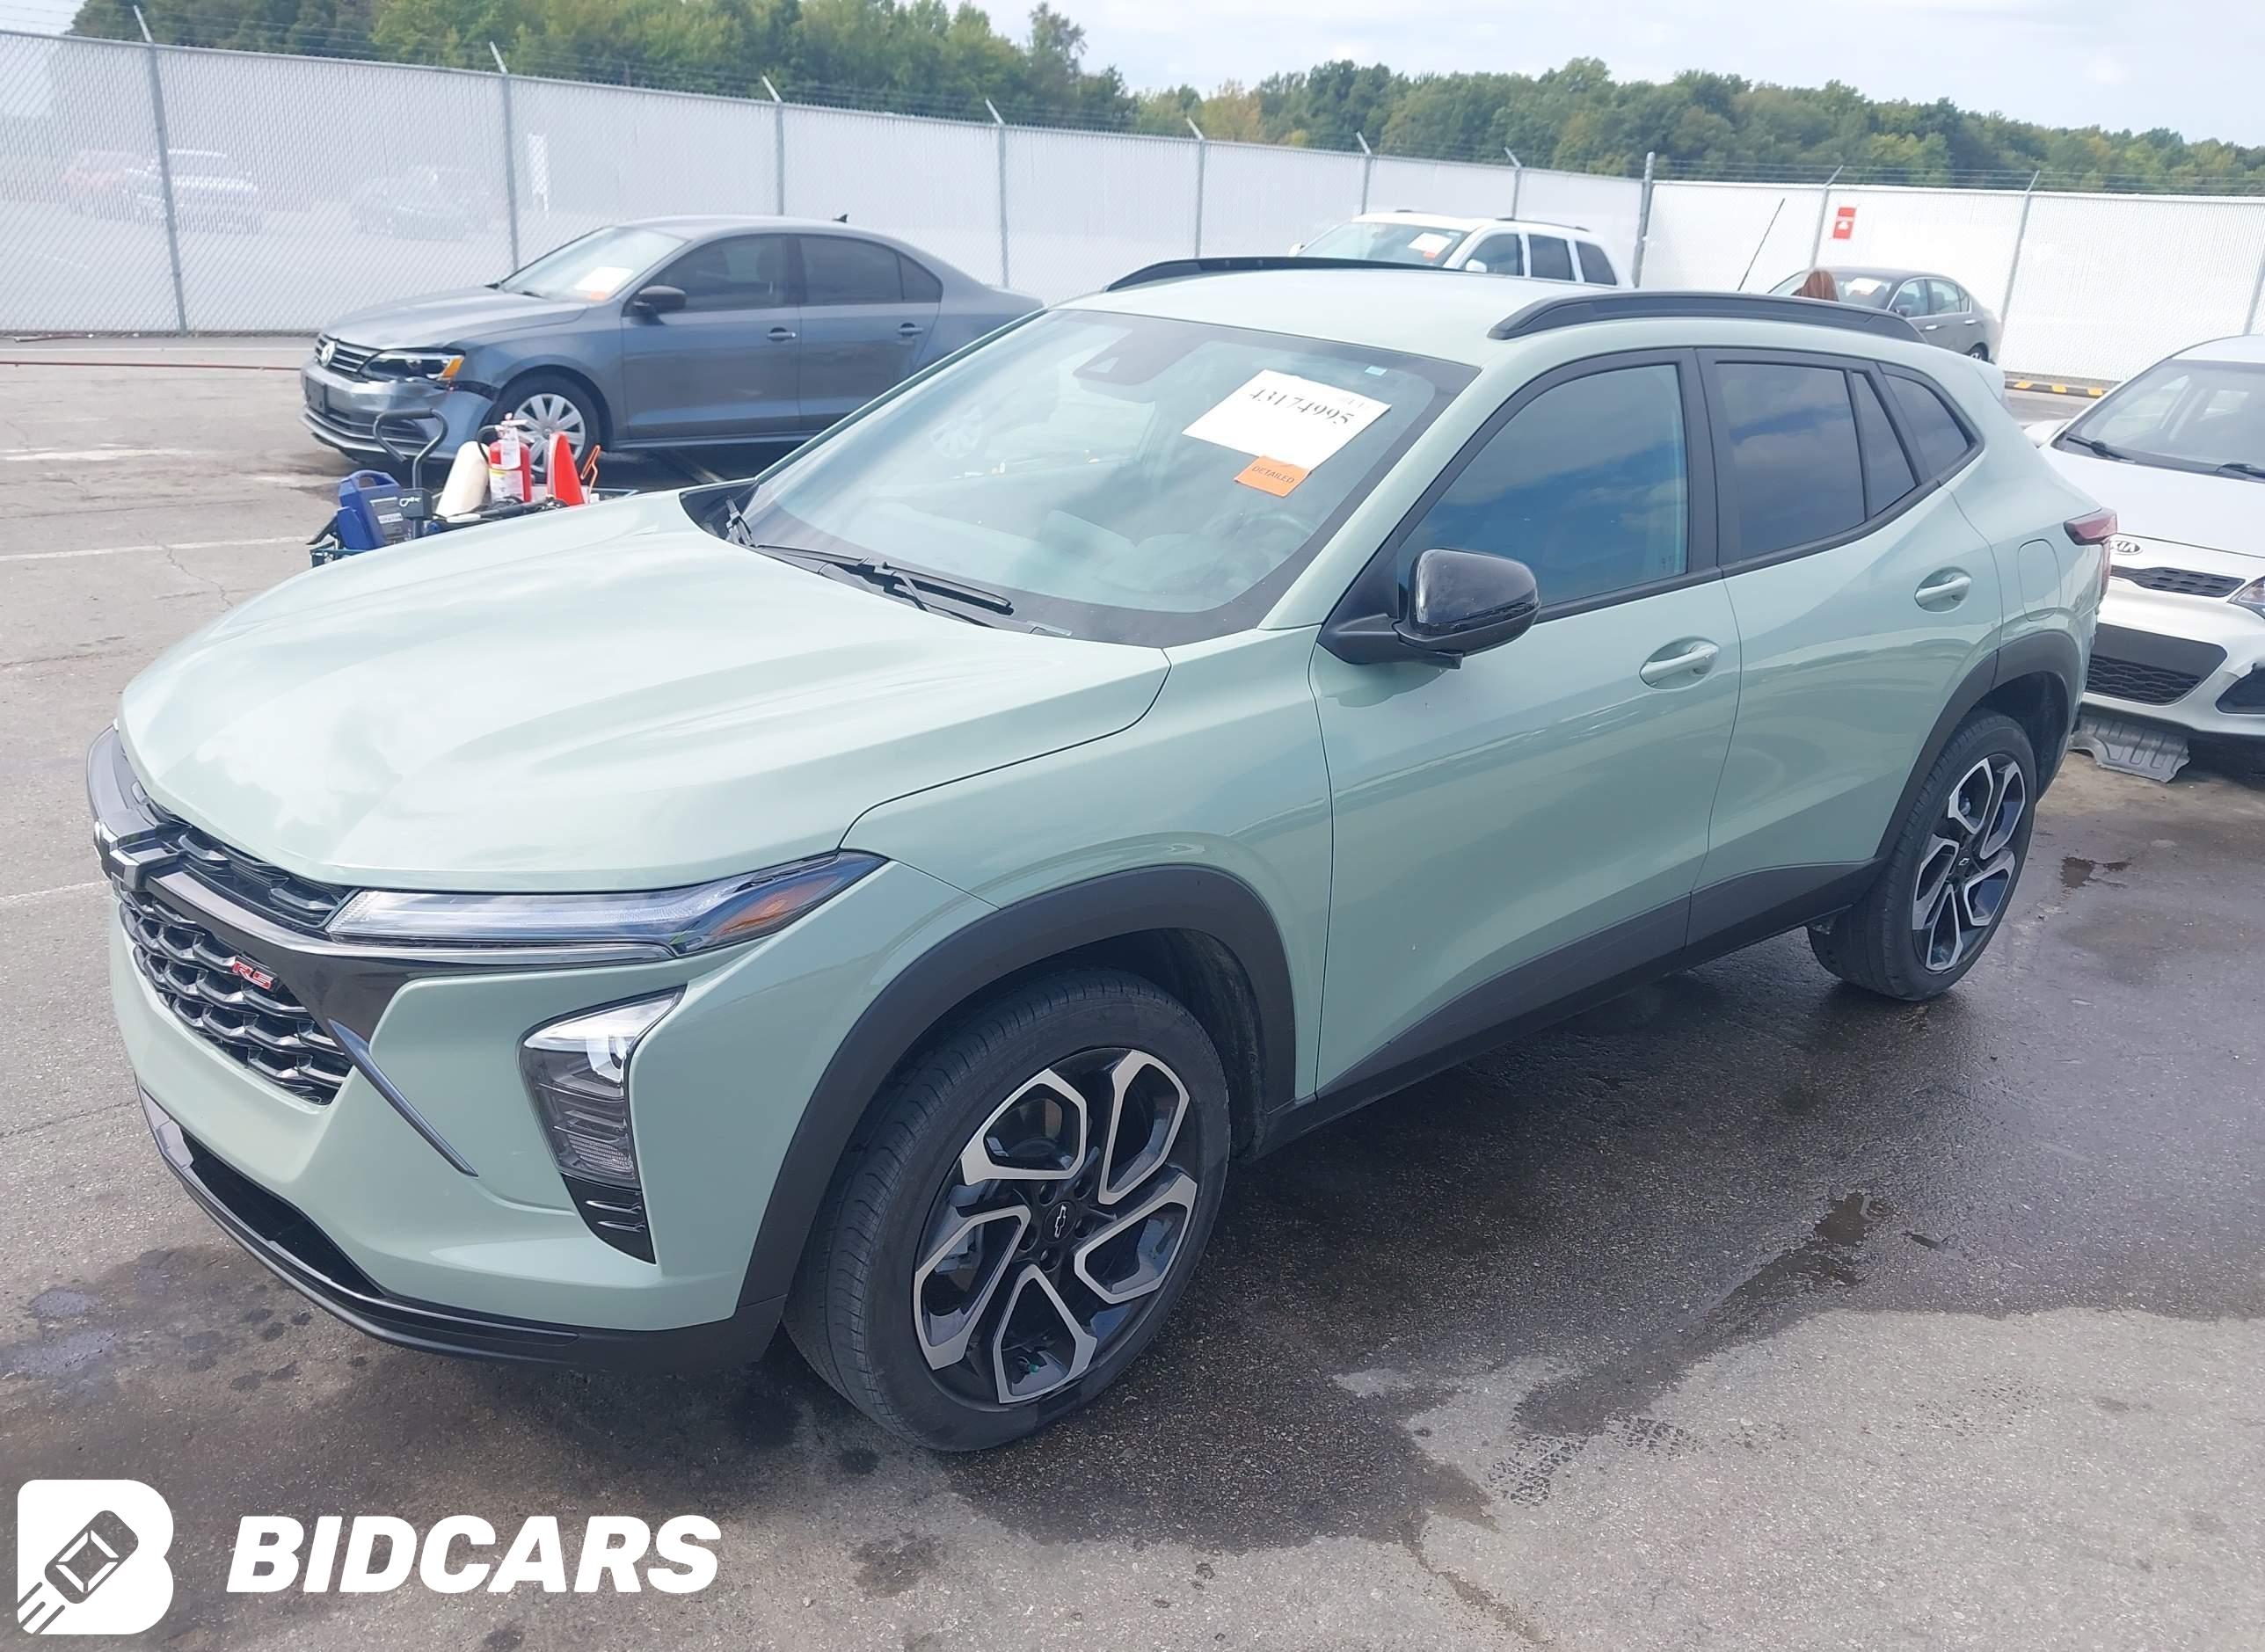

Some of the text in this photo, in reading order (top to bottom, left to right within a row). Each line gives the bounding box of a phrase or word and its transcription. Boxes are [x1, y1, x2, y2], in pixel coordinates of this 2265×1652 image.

[1249, 388, 1356, 425] 43174995
[1251, 465, 1295, 484] DETAILED
[232, 960, 273, 989] RS
